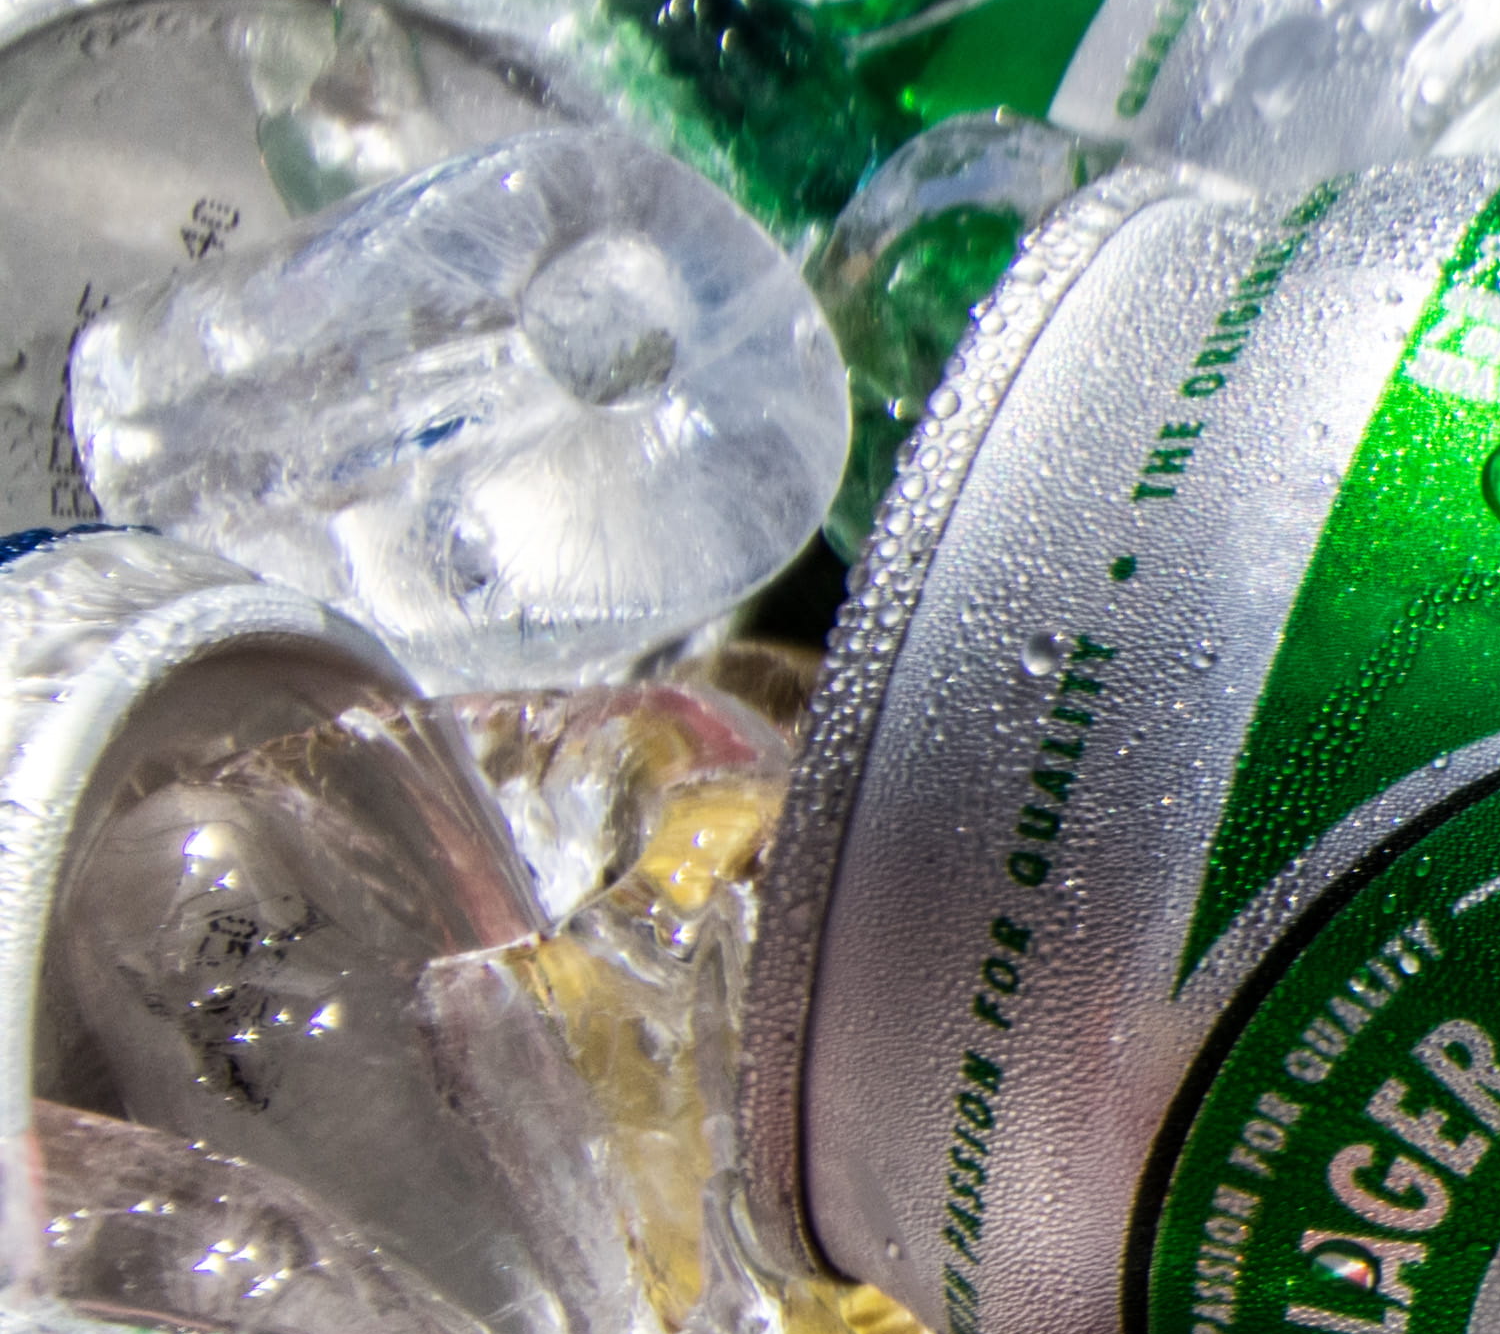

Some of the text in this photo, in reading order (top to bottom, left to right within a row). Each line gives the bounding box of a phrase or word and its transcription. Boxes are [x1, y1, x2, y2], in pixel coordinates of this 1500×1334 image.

[940, 1049, 1002, 1259] PASSION
[973, 913, 1034, 1030] FOR
[1008, 631, 1117, 888] QUALITY
[1131, 417, 1205, 503] THE
[1226, 1091, 1304, 1179] FOR
[1284, 917, 1445, 1084] QUALITY
